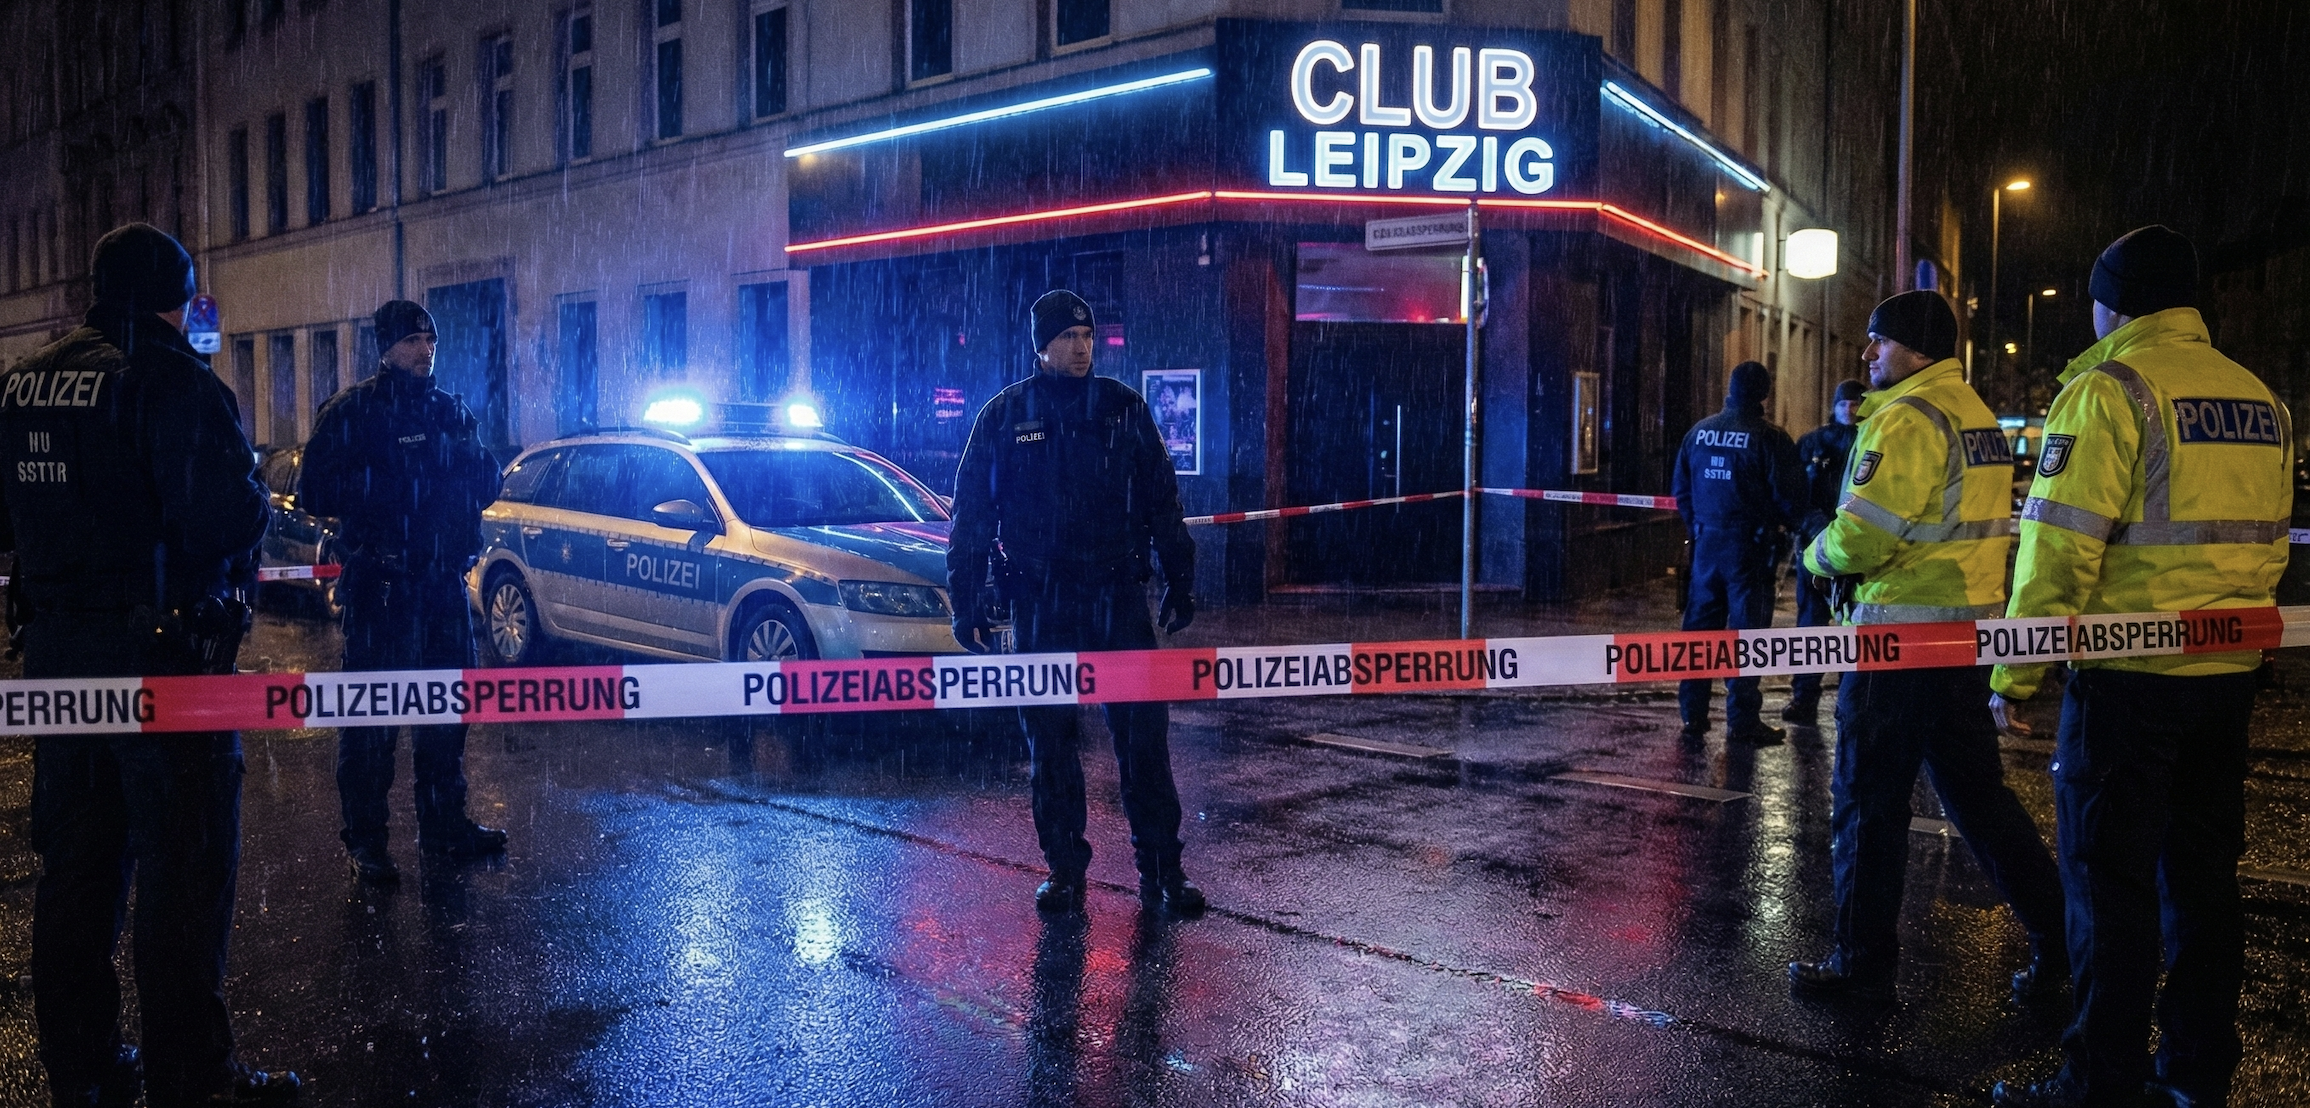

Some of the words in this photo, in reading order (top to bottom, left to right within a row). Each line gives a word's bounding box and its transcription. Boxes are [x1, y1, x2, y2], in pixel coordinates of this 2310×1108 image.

[1291, 40, 1537, 130] CLUB
[1268, 130, 1554, 194] LEIPZIG
[1, 371, 105, 408] POLIZEI
[1695, 429, 1750, 449] POLIZEI
[2177, 401, 2279, 443] POLIZEI
[17, 461, 67, 482] SSTTR
[626, 553, 700, 590] POLIZEI
[266, 676, 640, 719] POLIZEIABSPERRUNG
[743, 663, 1096, 706] POLIZEIABSPERRUNG
[1193, 648, 1518, 690] POLIZEIABSPERRUNG
[1977, 616, 2243, 658] POLIZEIABSPERRUNG
